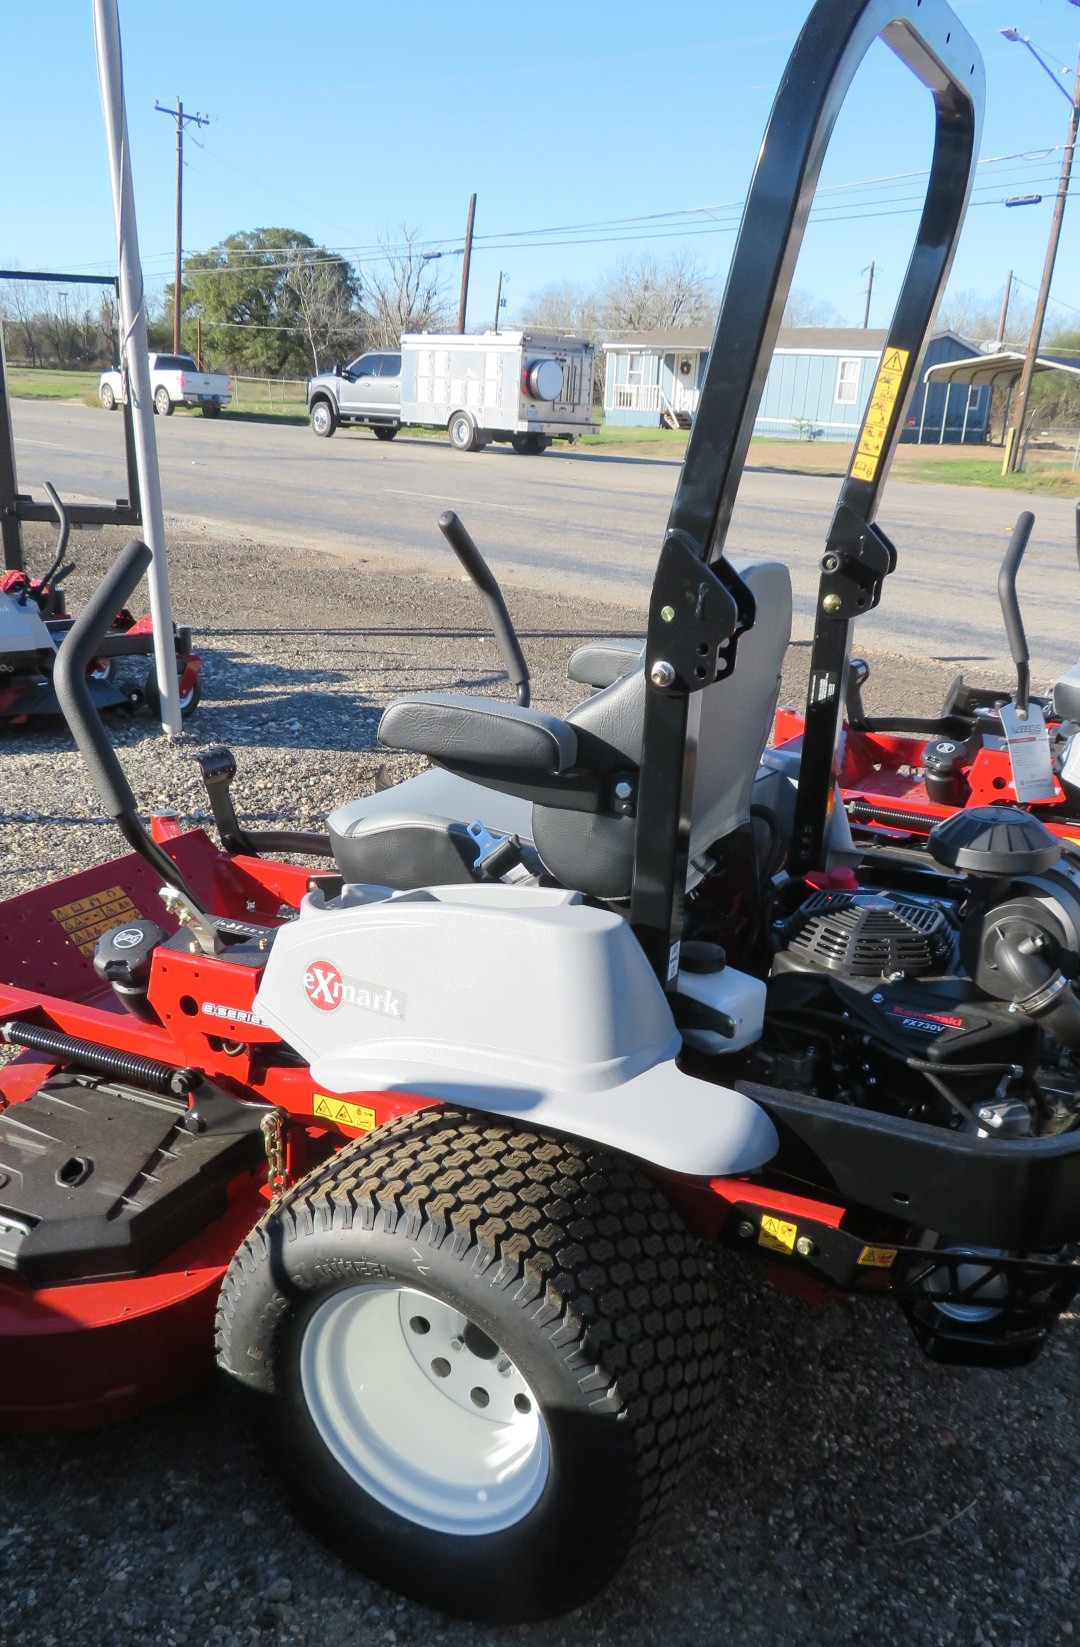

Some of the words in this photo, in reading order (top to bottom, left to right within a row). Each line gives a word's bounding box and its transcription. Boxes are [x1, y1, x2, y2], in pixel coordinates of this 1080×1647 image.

[303, 967, 400, 1016] eXmark
[202, 1003, 268, 1027] E-SERIE
[893, 1006, 963, 1028] Kawasaki
[902, 1018, 946, 1032] FX730V
